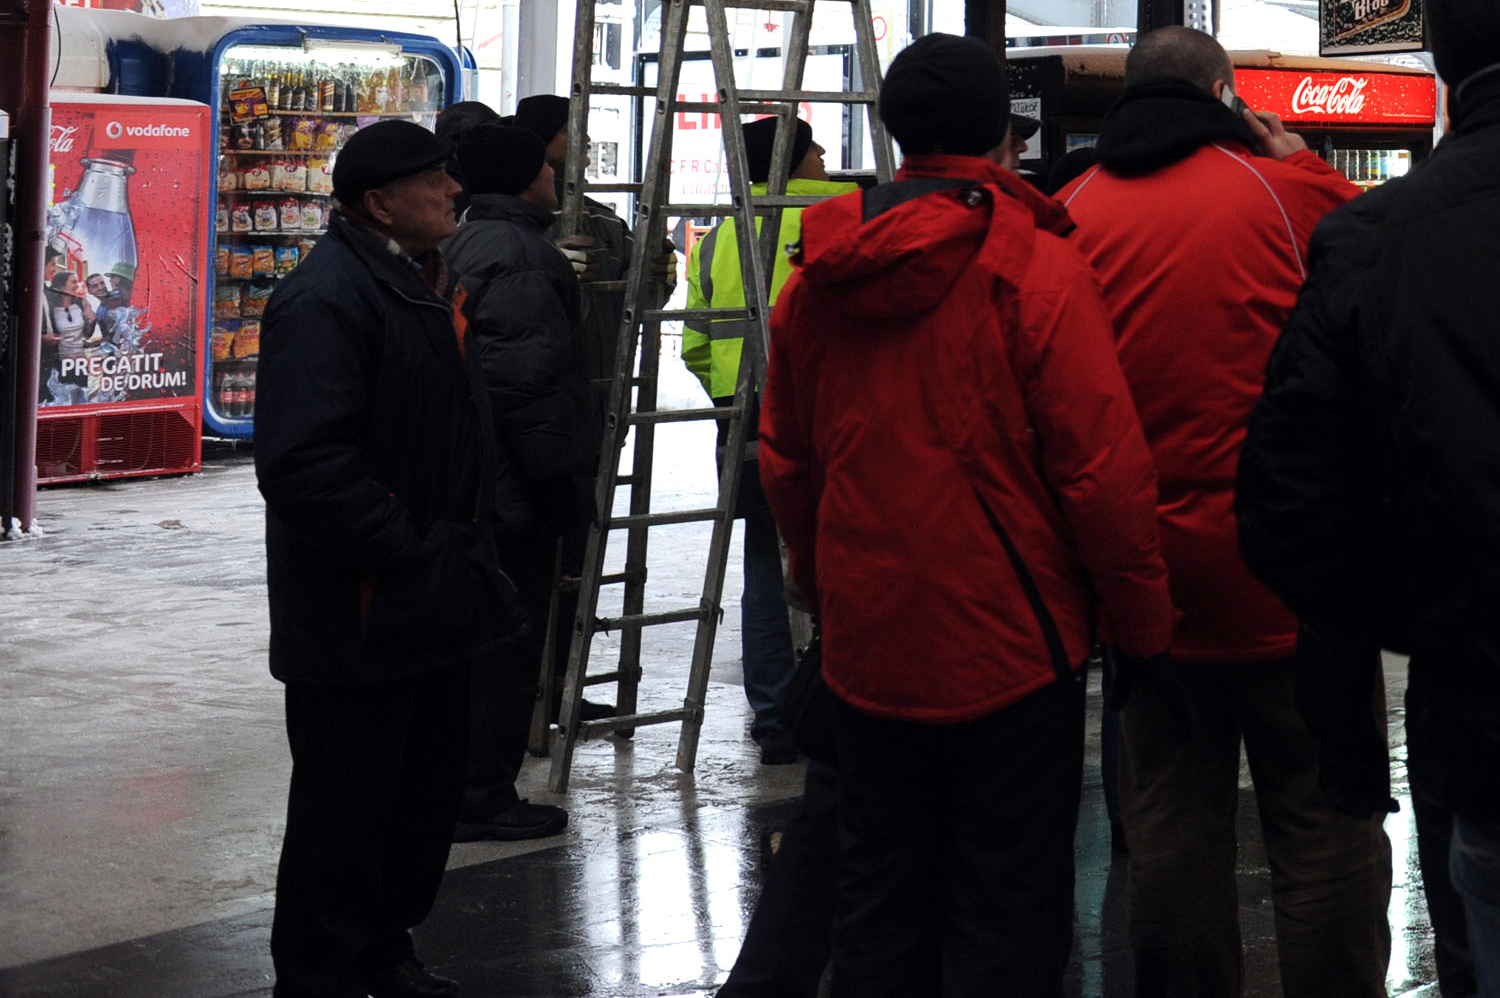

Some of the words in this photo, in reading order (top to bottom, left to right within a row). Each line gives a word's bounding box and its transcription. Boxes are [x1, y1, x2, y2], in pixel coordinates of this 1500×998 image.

[1291, 76, 1368, 114] Coca-Cola
[126, 124, 190, 137] vodafone
[101, 376, 125, 392] DE
[129, 371, 187, 389] DRUM!
